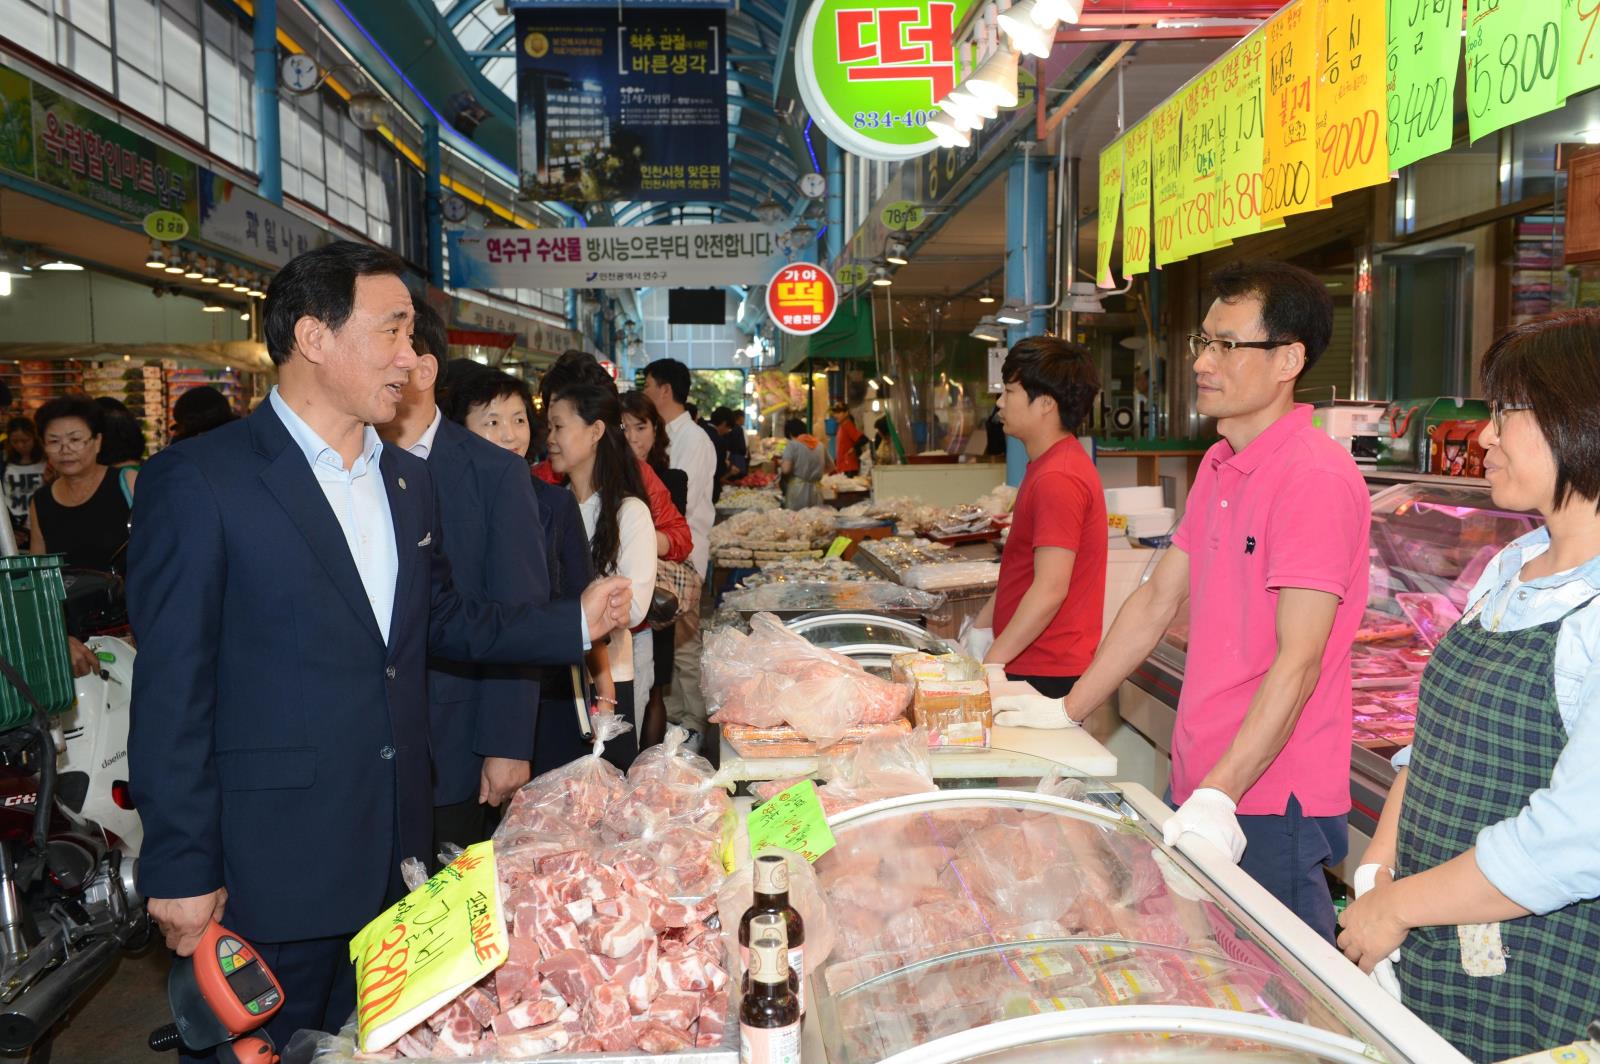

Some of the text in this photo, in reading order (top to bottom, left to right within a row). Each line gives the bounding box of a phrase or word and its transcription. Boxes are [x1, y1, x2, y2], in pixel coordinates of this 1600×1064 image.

[629, 34, 656, 51] 척추
[836, 2, 955, 105] 떡
[1323, 14, 1362, 85] 등심
[1281, 76, 1310, 127] 불고기
[640, 166, 684, 178] 인천시청
[487, 232, 774, 263] 연수구 수산물 방사능으로부터 안전합니다.
[600, 271, 667, 281] 인천광역시 연수구
[785, 270, 817, 281] 가야
[778, 282, 824, 313] 떡
[783, 315, 821, 325] 맞춤전문
[472, 914, 501, 962] SALE
